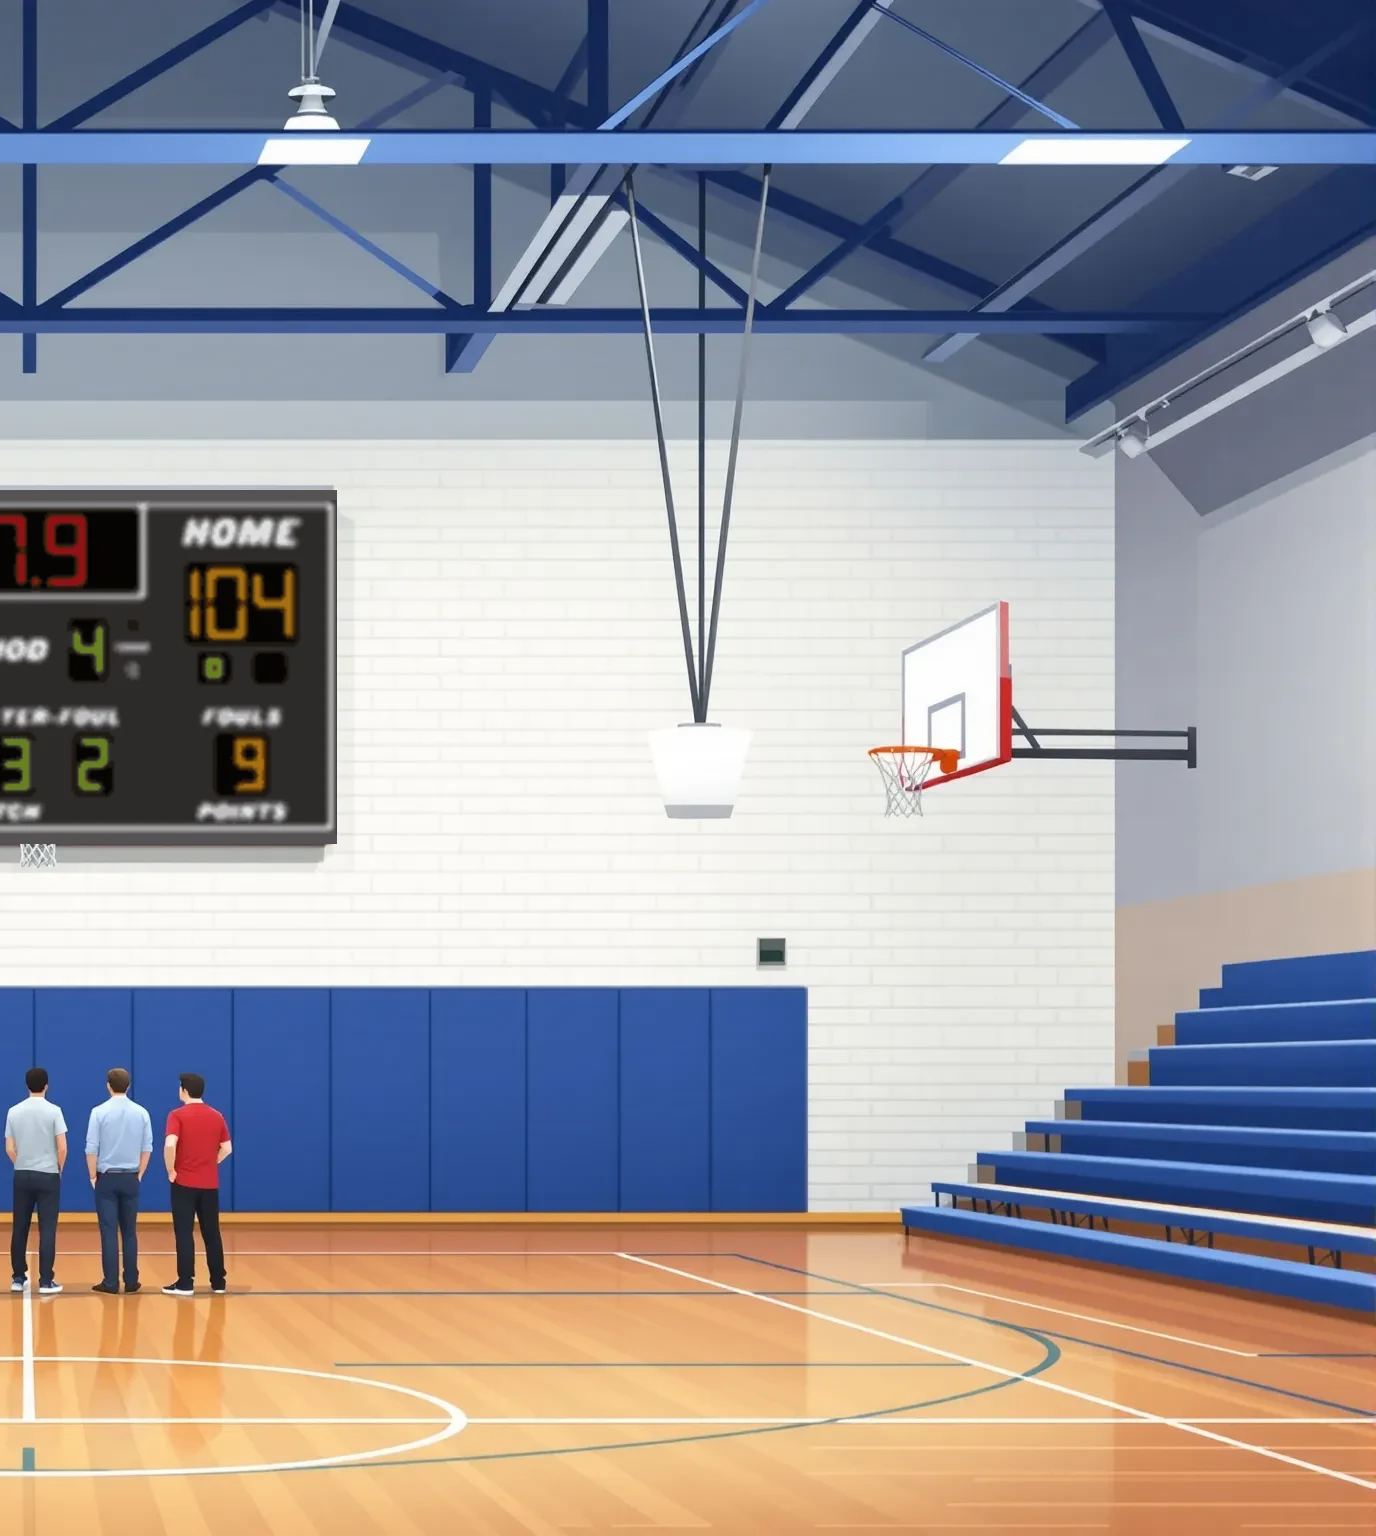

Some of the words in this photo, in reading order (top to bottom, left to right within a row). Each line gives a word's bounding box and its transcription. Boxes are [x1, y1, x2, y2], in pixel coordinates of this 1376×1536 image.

[181, 516, 302, 549] HOME
[190, 567, 295, 640] 104
[73, 626, 104, 672] 4
[78, 738, 109, 791] 2
[233, 737, 266, 791] 9
